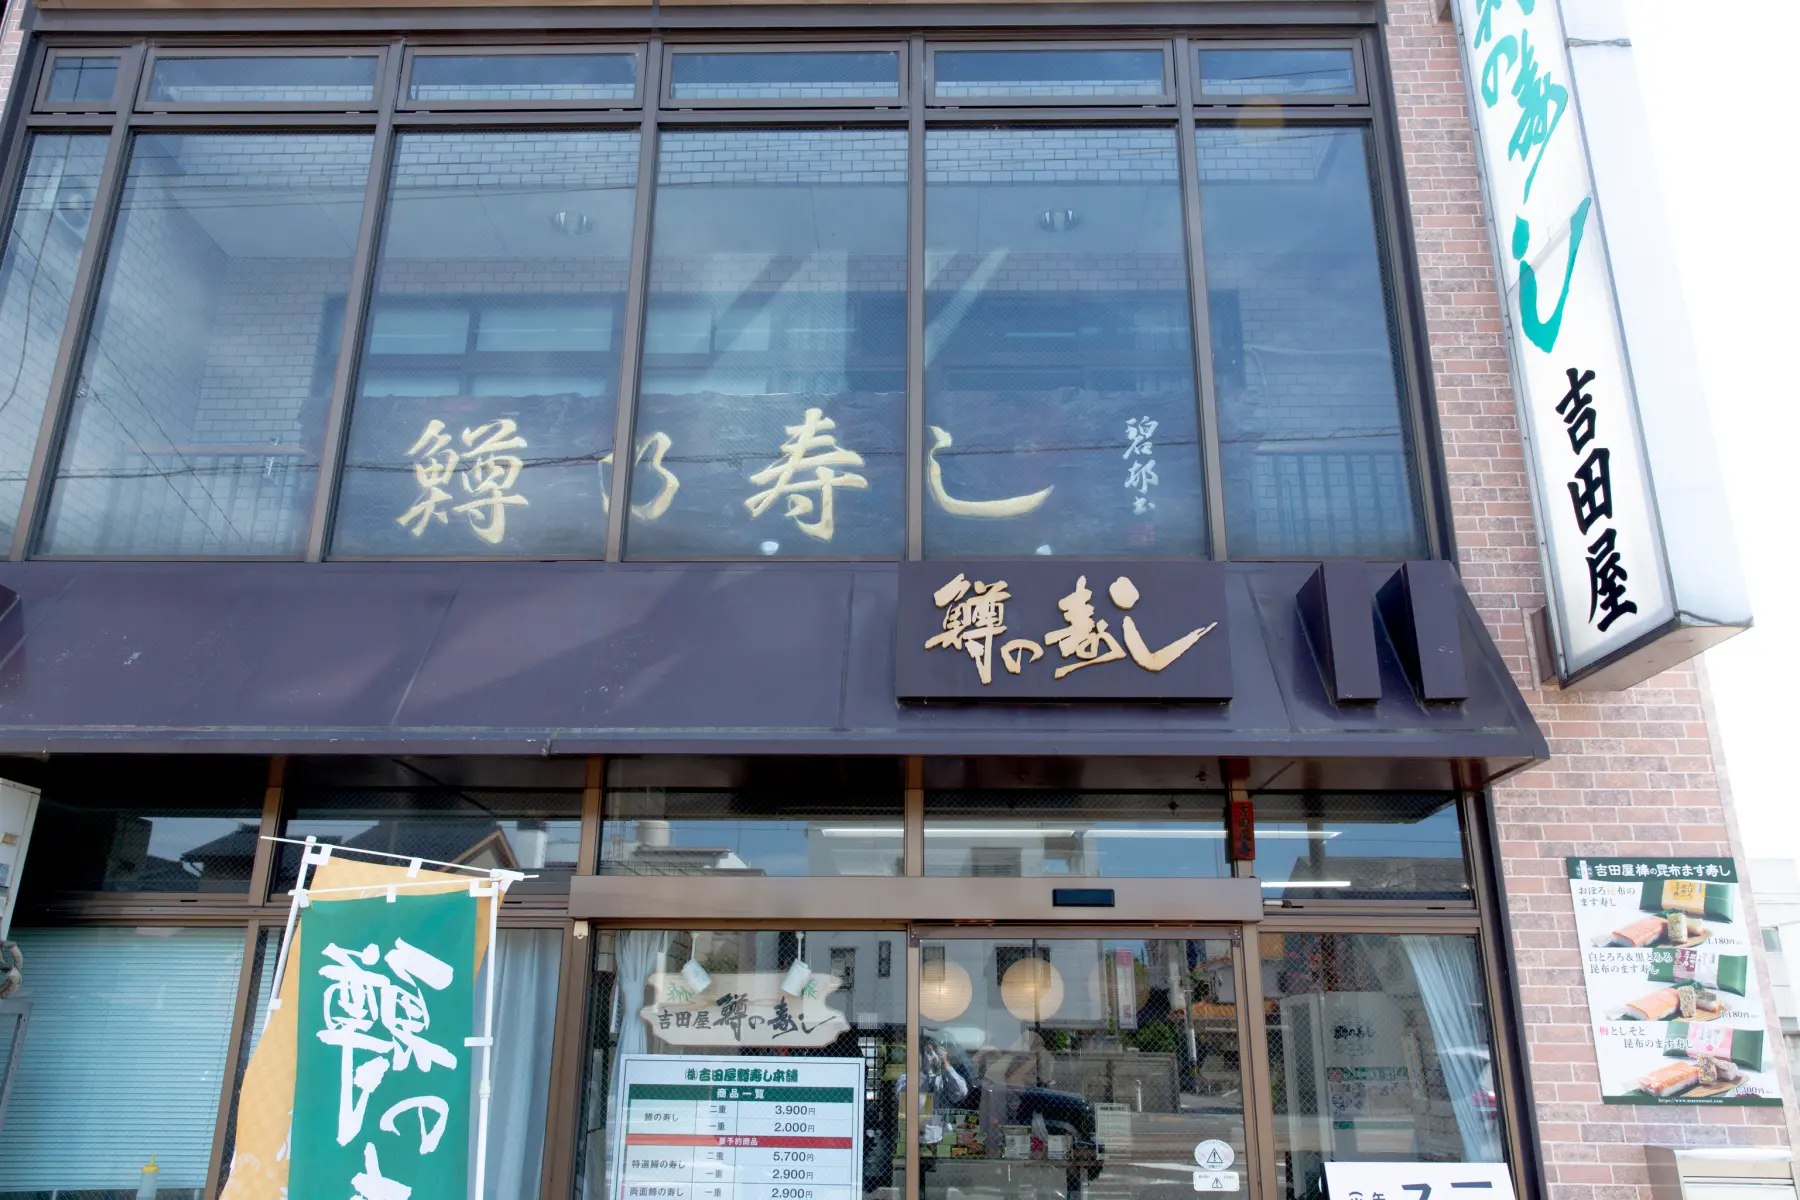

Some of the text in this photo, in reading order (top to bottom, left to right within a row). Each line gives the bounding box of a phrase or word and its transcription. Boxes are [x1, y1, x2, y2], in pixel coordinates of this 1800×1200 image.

[1474, 0, 1592, 353] の寿し
[1554, 367, 1638, 631] 吉田屋
[316, 937, 458, 1200] 鱒の
[716, 1088, 765, 1100] 商品一覧
[709, 1104, 727, 1115] 二重
[775, 1105, 816, 1117] 3,900円
[644, 1112, 680, 1122] 鱒の寿し
[708, 1122, 726, 1132] 一重
[774, 1122, 815, 1133] 2,000円
[718, 1136, 758, 1147] 要予約商品
[707, 1151, 724, 1161] 二重
[773, 1151, 814, 1163] 5,700円
[631, 1159, 686, 1170] 特選鱒の寿し
[705, 1169, 723, 1179] 一重
[772, 1169, 814, 1181] 2,900円
[629, 1186, 685, 1198] 両面鱒の寿し
[704, 1188, 722, 1198] 一重
[771, 1188, 813, 1200] 2,900円
